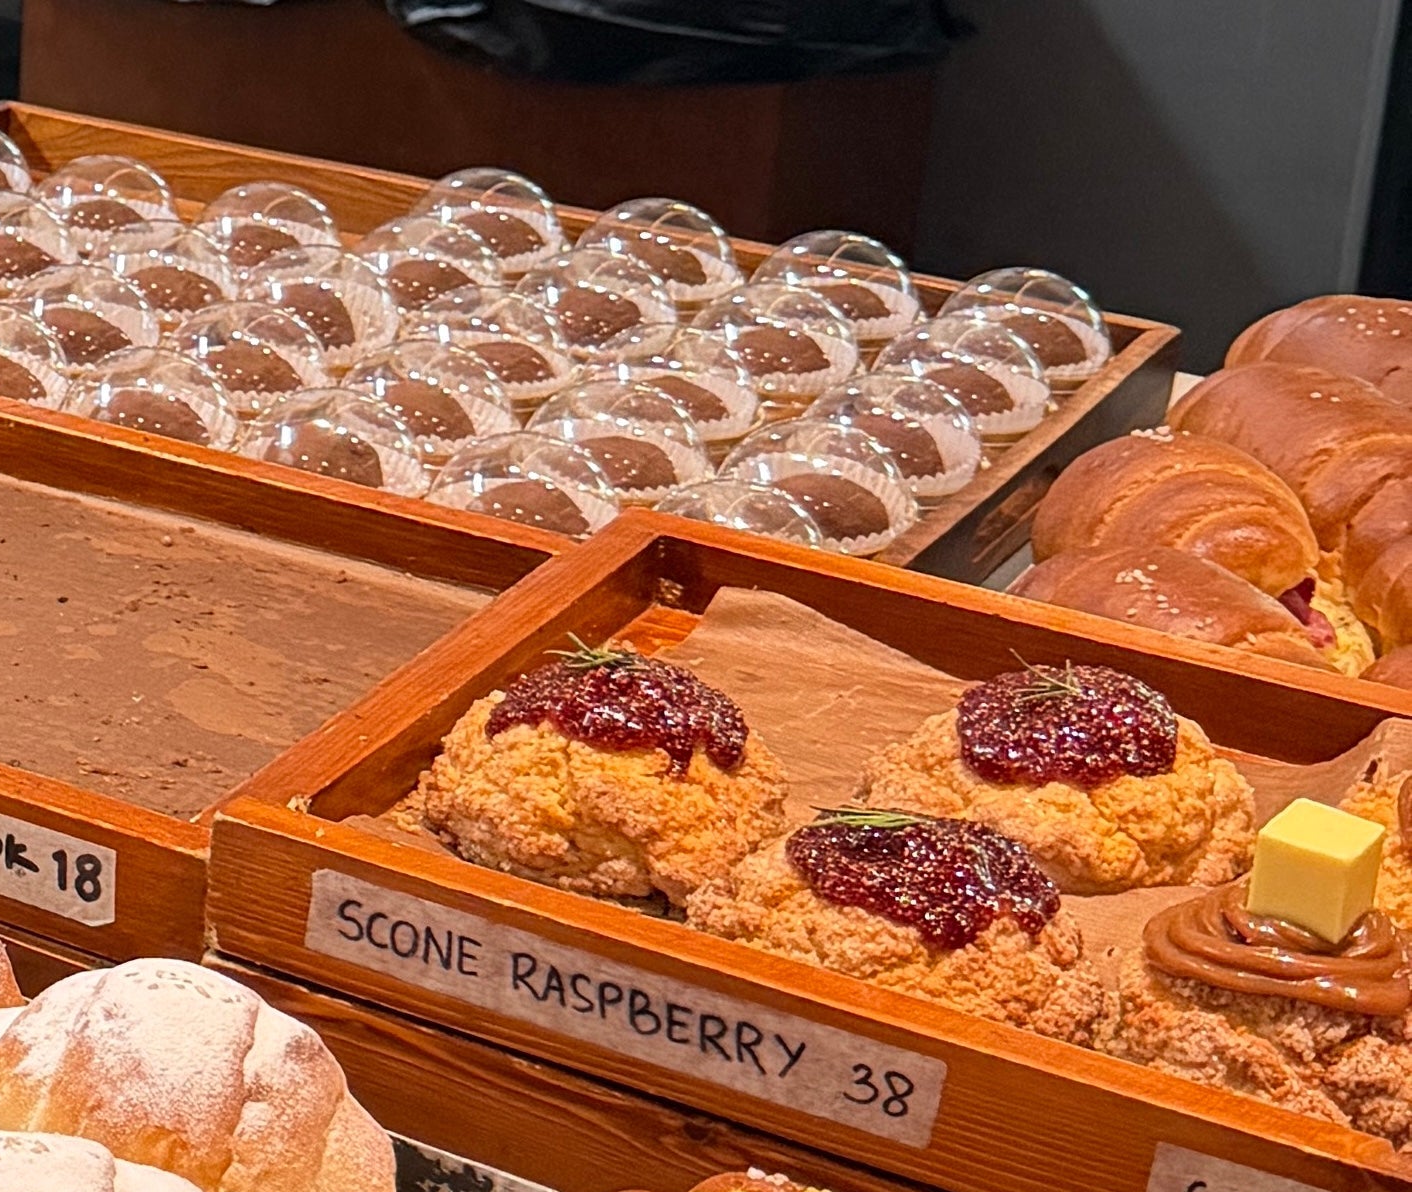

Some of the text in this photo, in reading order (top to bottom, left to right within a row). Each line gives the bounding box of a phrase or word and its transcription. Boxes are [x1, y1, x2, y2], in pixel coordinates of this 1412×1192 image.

[52, 848, 103, 903] 18
[336, 899, 916, 1118] SCONE RASPBERRY 38
